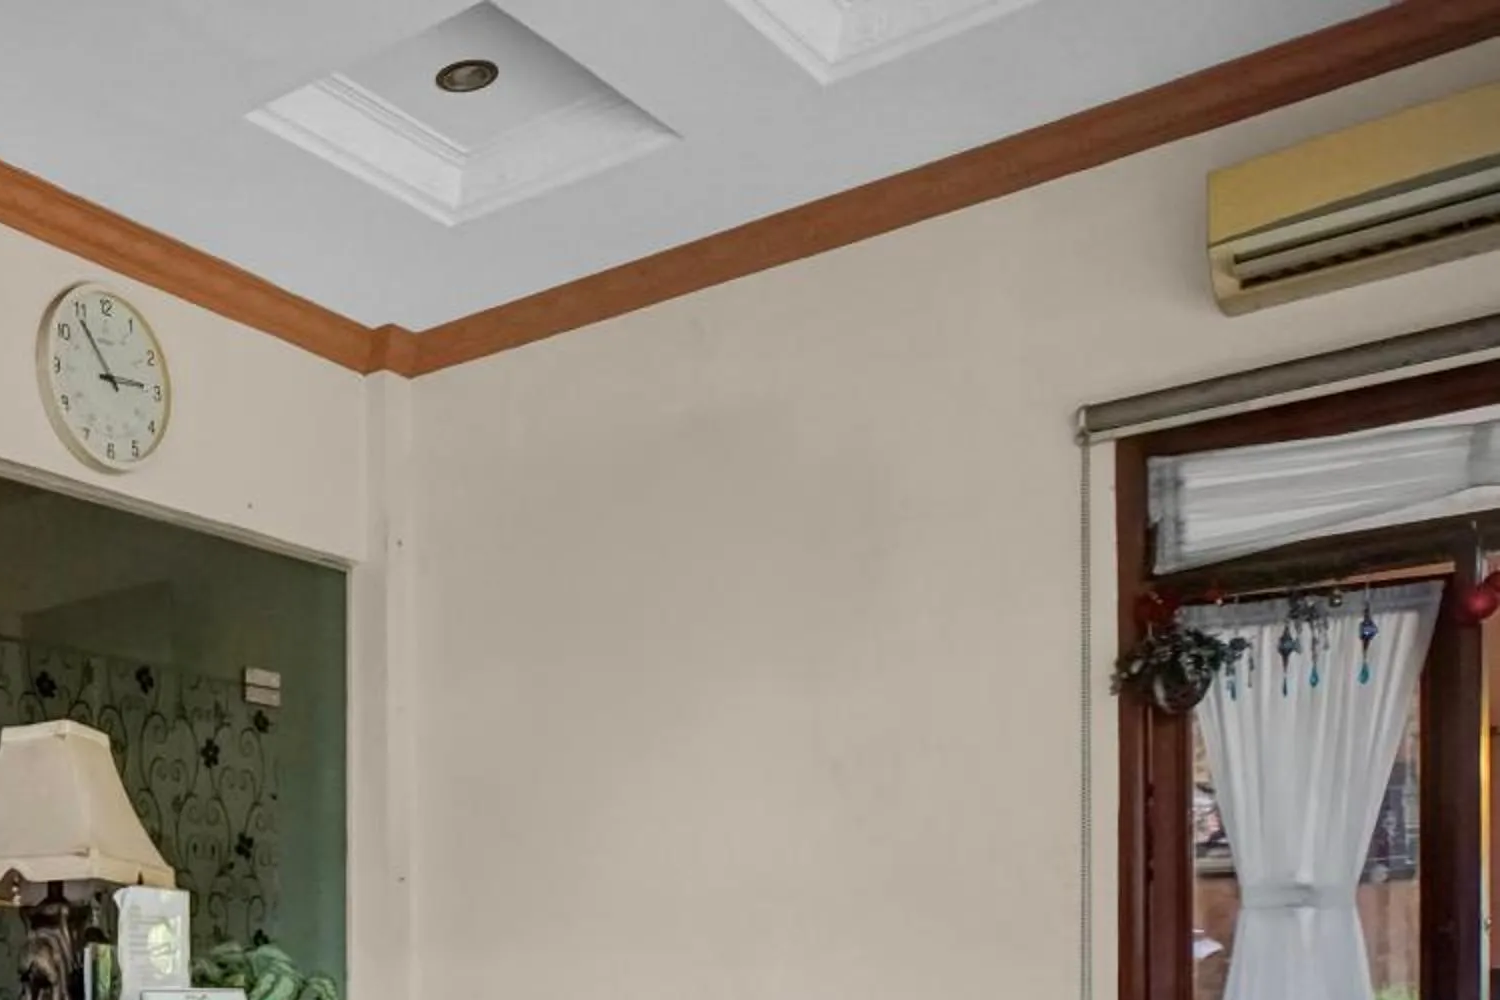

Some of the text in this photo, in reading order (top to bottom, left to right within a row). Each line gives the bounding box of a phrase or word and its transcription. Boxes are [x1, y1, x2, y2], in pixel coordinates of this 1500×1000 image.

[73, 300, 87, 319] 11
[57, 323, 70, 341] 10
[147, 349, 155, 367] 2
[131, 439, 139, 458] 5
